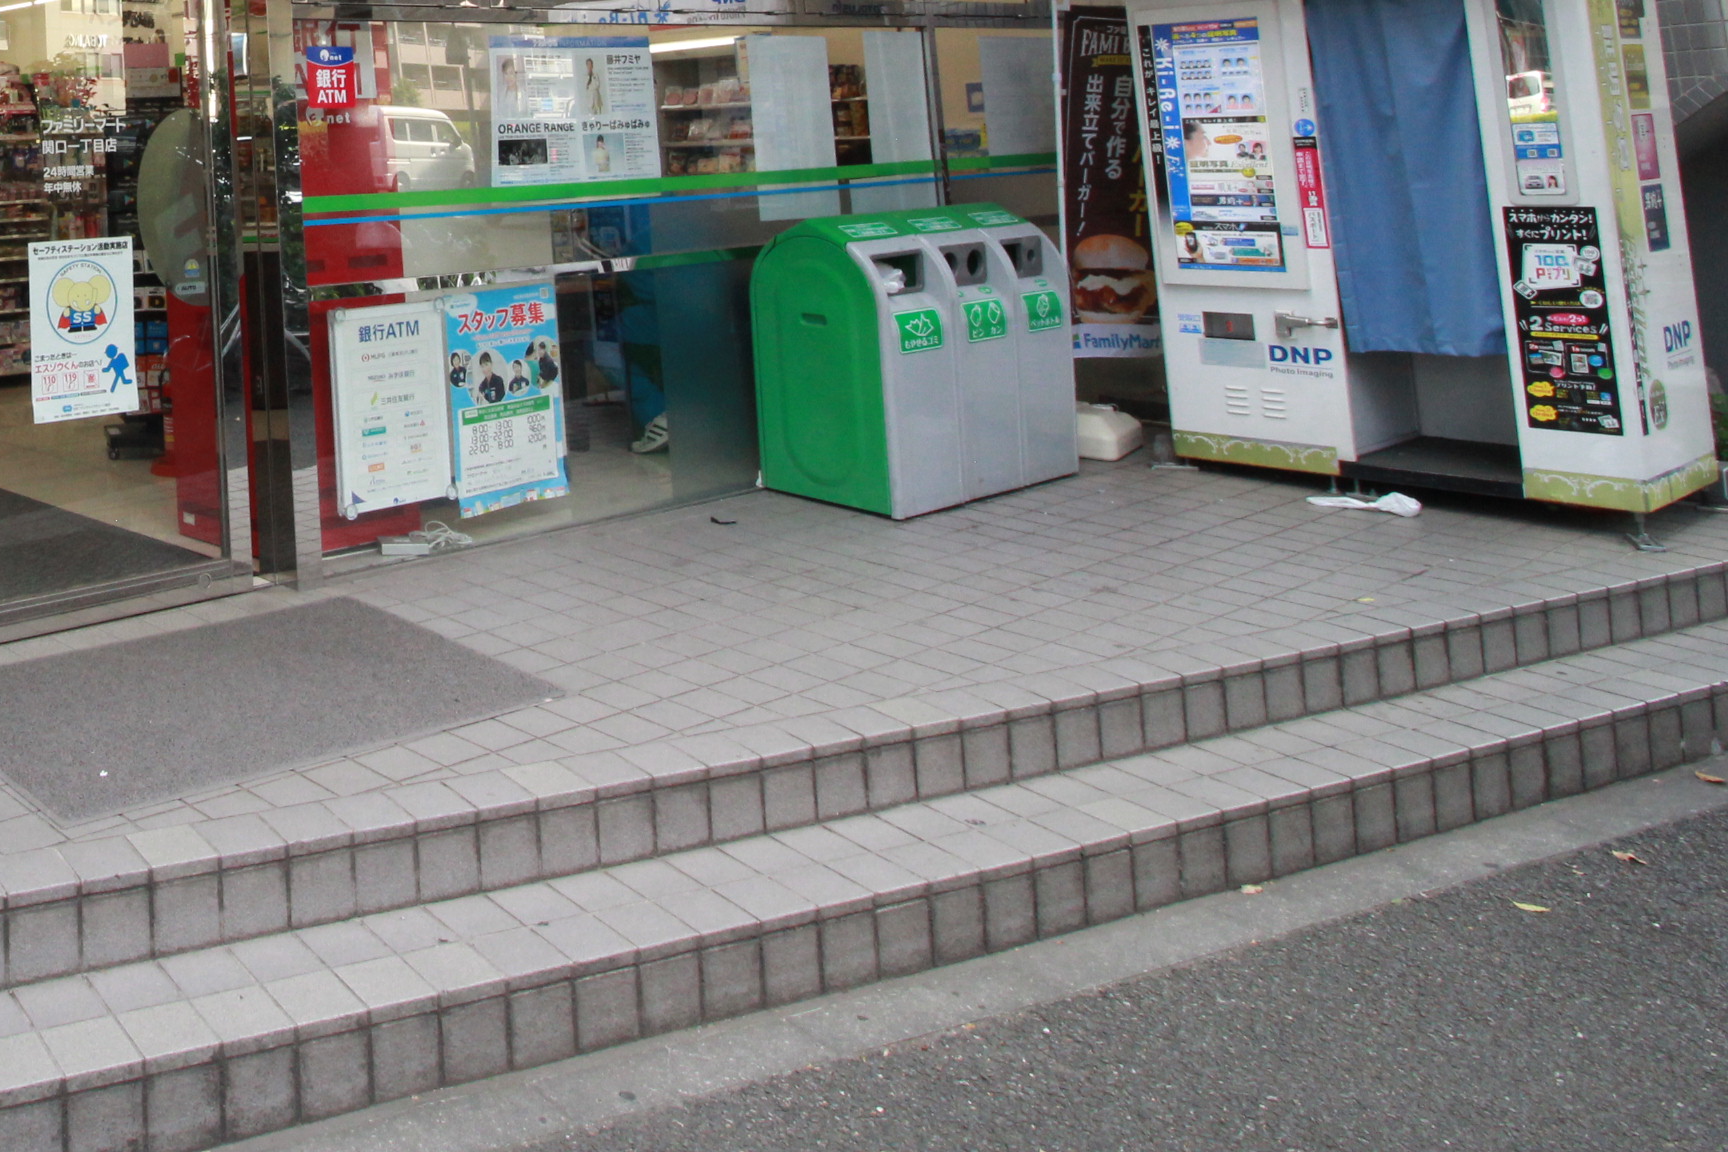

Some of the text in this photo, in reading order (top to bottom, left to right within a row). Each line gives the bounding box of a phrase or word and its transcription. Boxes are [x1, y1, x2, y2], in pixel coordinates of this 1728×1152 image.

[316, 69, 347, 88] 銀行
[317, 89, 347, 104] ATM
[41, 118, 126, 134] ファミリーマート
[498, 122, 575, 135] ORANGE RANGE
[1105, 77, 1133, 180] 自分で作る
[42, 138, 117, 154] 関口一丁目店
[1077, 74, 1104, 237] 出来立てバーガー!
[43, 165, 94, 178] 24時間営業
[43, 182, 82, 194] 年中無休
[73, 311, 92, 324] SS
[458, 301, 545, 334] スタッフ募集
[358, 320, 420, 343] 銀行ATM
[1545, 322, 1597, 334] Services
[1663, 320, 1691, 352] DNP
[1083, 333, 1160, 350] FamilyMart
[1268, 344, 1333, 365] DNP
[43, 373, 77, 385] 110 119
[1270, 366, 1334, 379] Photo Imaging
